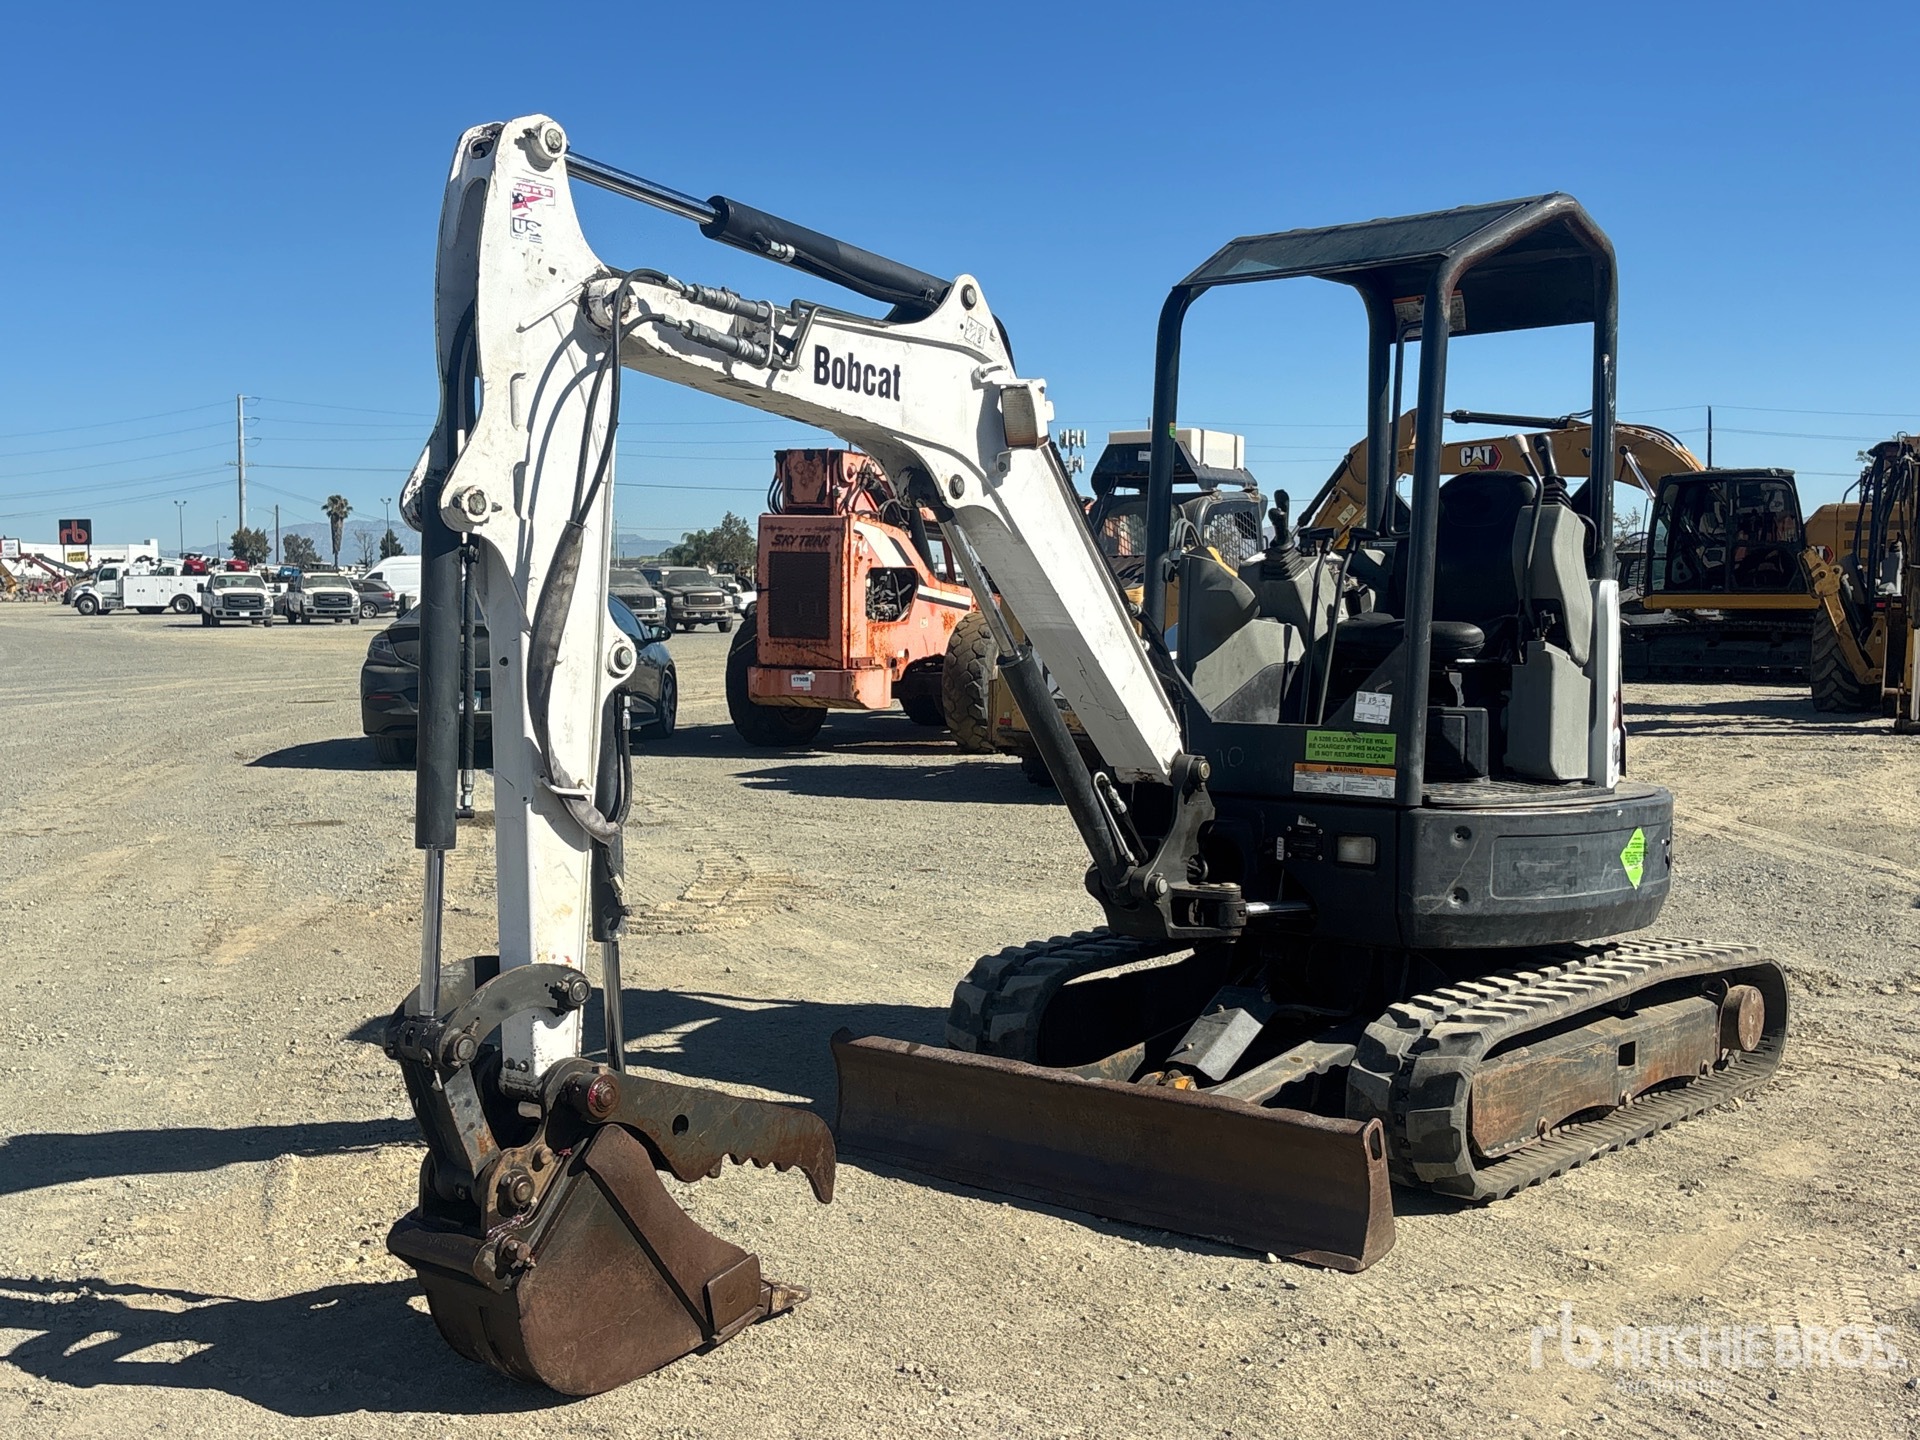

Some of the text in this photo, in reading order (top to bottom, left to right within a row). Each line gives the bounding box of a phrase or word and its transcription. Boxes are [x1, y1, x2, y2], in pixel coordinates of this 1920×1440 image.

[813, 344, 901, 402] Bobcat
[1460, 445, 1493, 467] CAT
[61, 520, 88, 544] rb
[1333, 751, 1365, 759] RETURNED
[1333, 766, 1364, 774] WARNING
